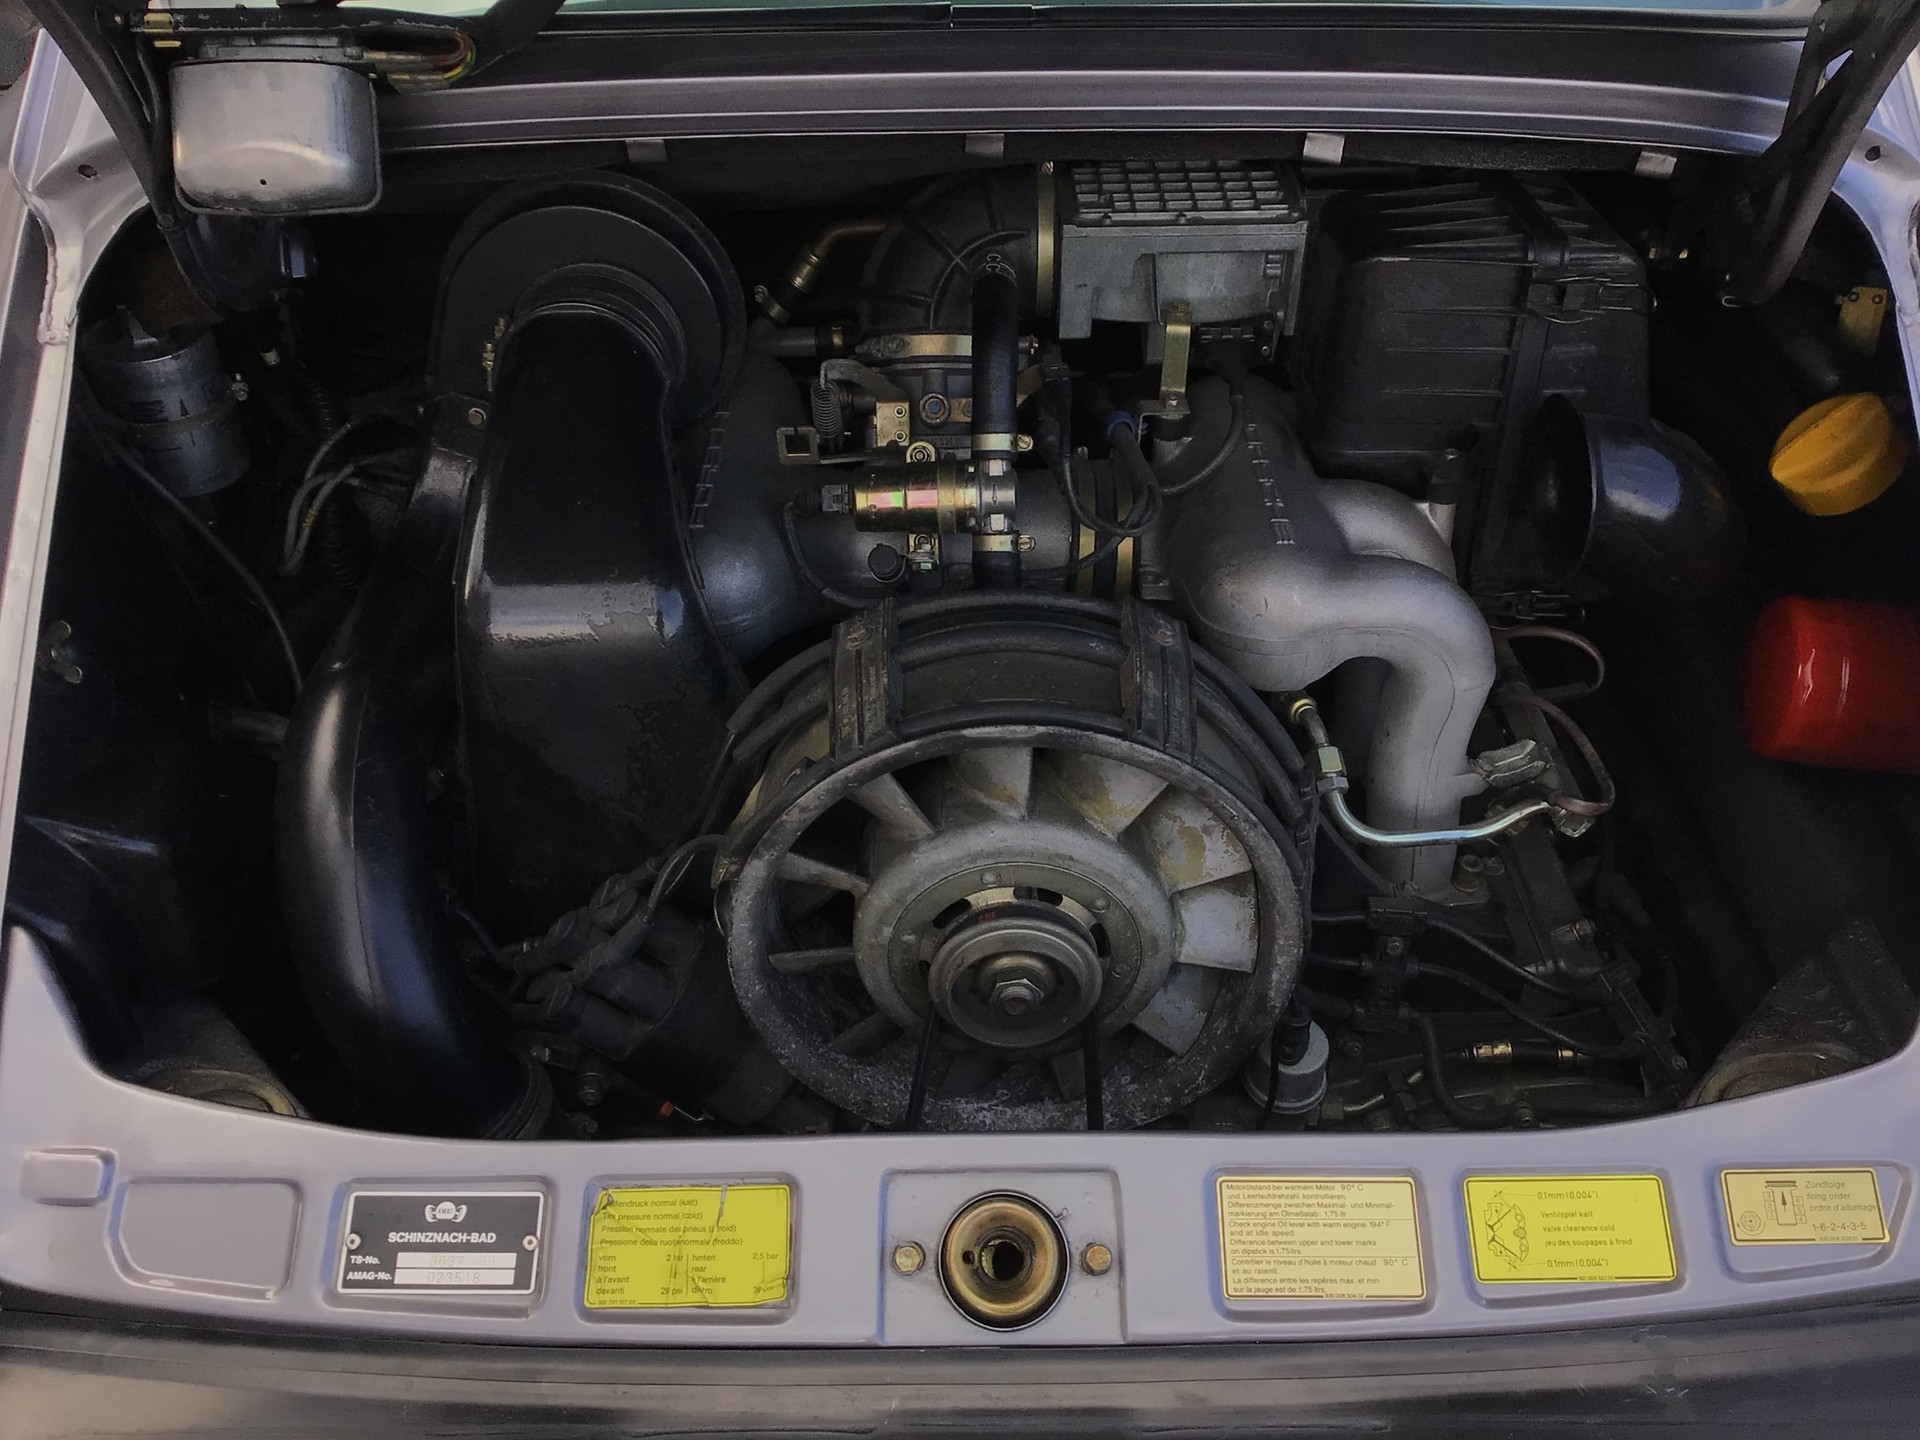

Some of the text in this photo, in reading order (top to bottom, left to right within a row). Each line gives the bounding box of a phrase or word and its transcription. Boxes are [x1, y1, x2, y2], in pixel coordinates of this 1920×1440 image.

[1357, 1183, 1364, 1191] C
[1806, 1192, 1851, 1201] firing order
[679, 1199, 698, 1207] (kalt)
[1227, 1201, 1282, 1210] Differenzmenge
[437, 1207, 454, 1215] AMAG
[1808, 1203, 1877, 1213] ordre d'allumage
[617, 1213, 652, 1221] pressure
[653, 1212, 680, 1220] normal
[1228, 1210, 1267, 1219] markierung
[1540, 1210, 1593, 1219] Ventilspiel kalt
[1229, 1220, 1250, 1228] Check
[1253, 1221, 1277, 1229] engine
[1386, 1220, 1391, 1228] F
[1562, 1224, 1598, 1232] clearance
[1600, 1224, 1615, 1232] cold
[1812, 1222, 1867, 1232] 1-6-2-4-3-5
[601, 1225, 634, 1233] Pression
[682, 1226, 707, 1234] pneus
[387, 1231, 497, 1243] SCHINZNACH-BAD
[600, 1238, 638, 1246] Pressione
[640, 1238, 658, 1246] della
[712, 1237, 743, 1246] (freddo)
[1230, 1238, 1266, 1246] Difference
[1544, 1240, 1557, 1248] jeu
[1572, 1239, 1607, 1247] soupapes
[1615, 1238, 1632, 1246] froid
[752, 1252, 764, 1260] 2,5
[766, 1252, 779, 1260] bar
[1241, 1248, 1268, 1256] dipstick
[350, 1255, 381, 1265] TS-No.
[1322, 1258, 1328, 1266] à
[1401, 1258, 1408, 1266] C
[346, 1271, 480, 1284] AMAG-No. 023518
[1310, 1276, 1338, 1285] repères
[595, 1287, 625, 1295] davanti
[1253, 1287, 1273, 1295] jauge
